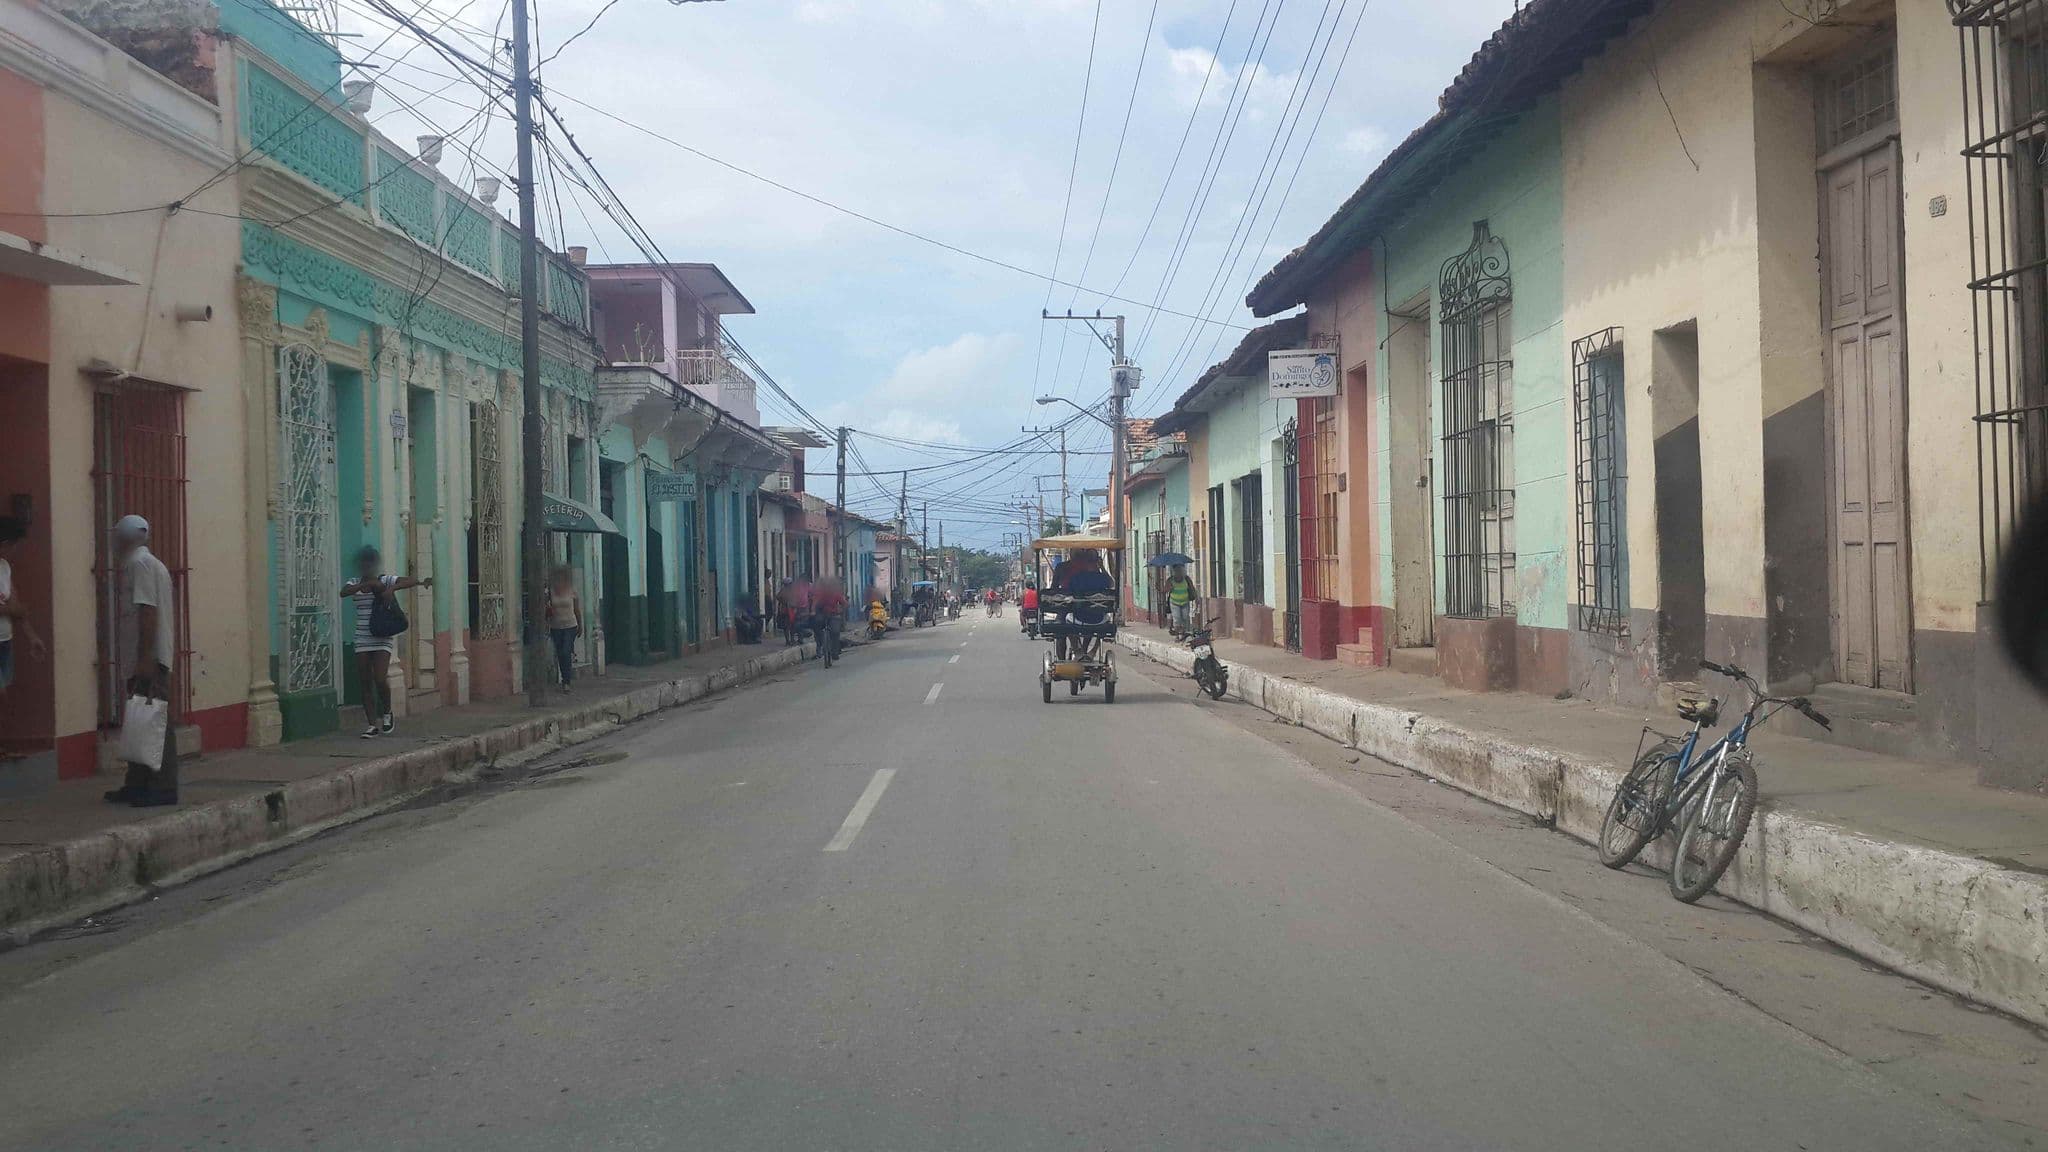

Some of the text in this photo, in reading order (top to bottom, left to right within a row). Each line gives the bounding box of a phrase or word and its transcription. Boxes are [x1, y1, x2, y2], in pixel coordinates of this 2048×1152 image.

[1287, 366, 1311, 374] Santo
[1272, 372, 1311, 381] Domingo
[543, 504, 585, 521] FETERIA
